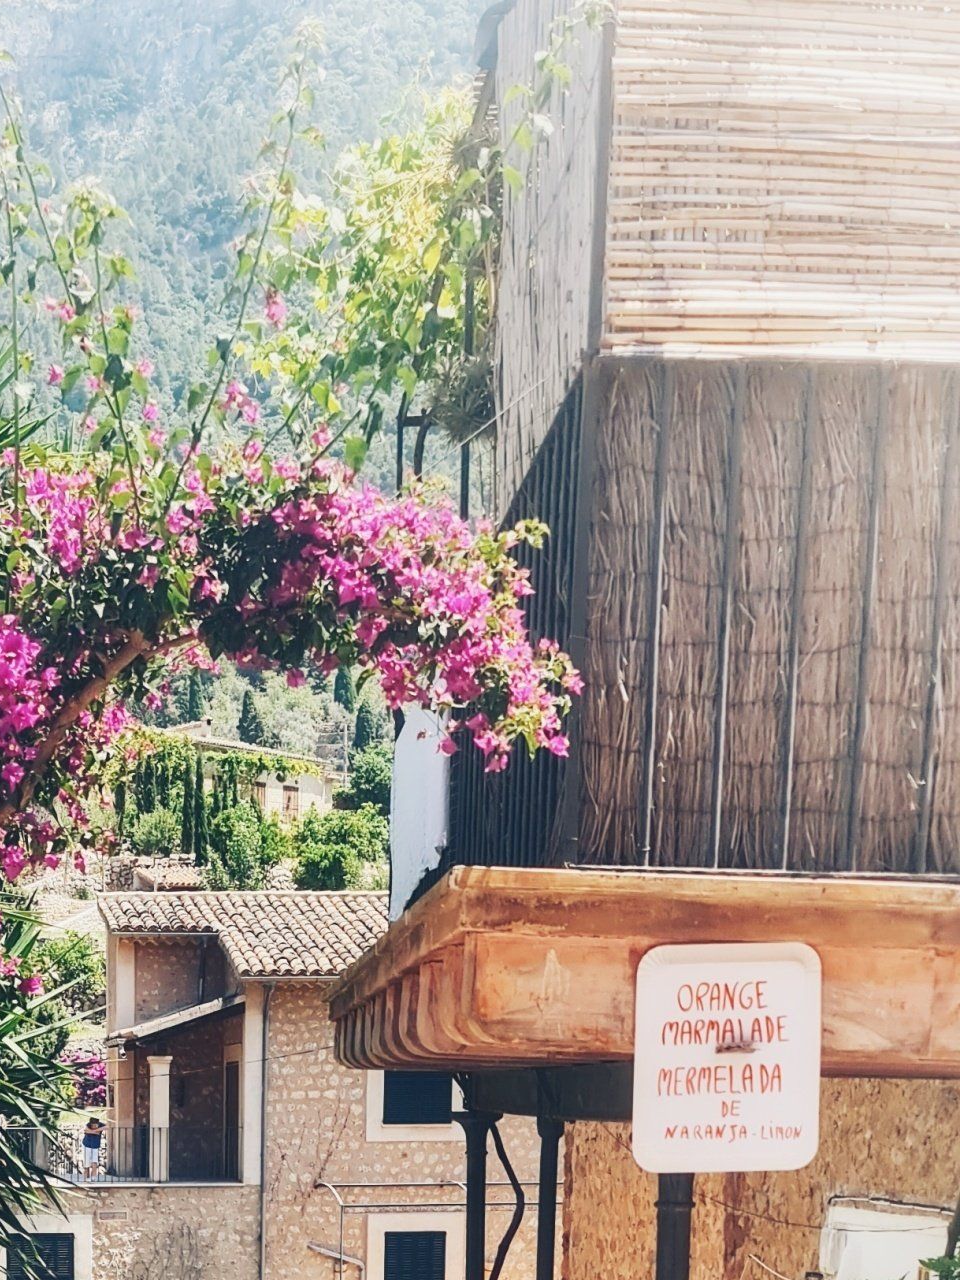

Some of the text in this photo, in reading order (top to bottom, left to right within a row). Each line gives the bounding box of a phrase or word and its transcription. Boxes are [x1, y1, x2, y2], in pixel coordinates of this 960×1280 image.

[677, 980, 768, 1012] ORANGE
[661, 1014, 790, 1045] MARMALADE
[657, 1063, 783, 1096] MERMELADA
[721, 1099, 741, 1118] DE
